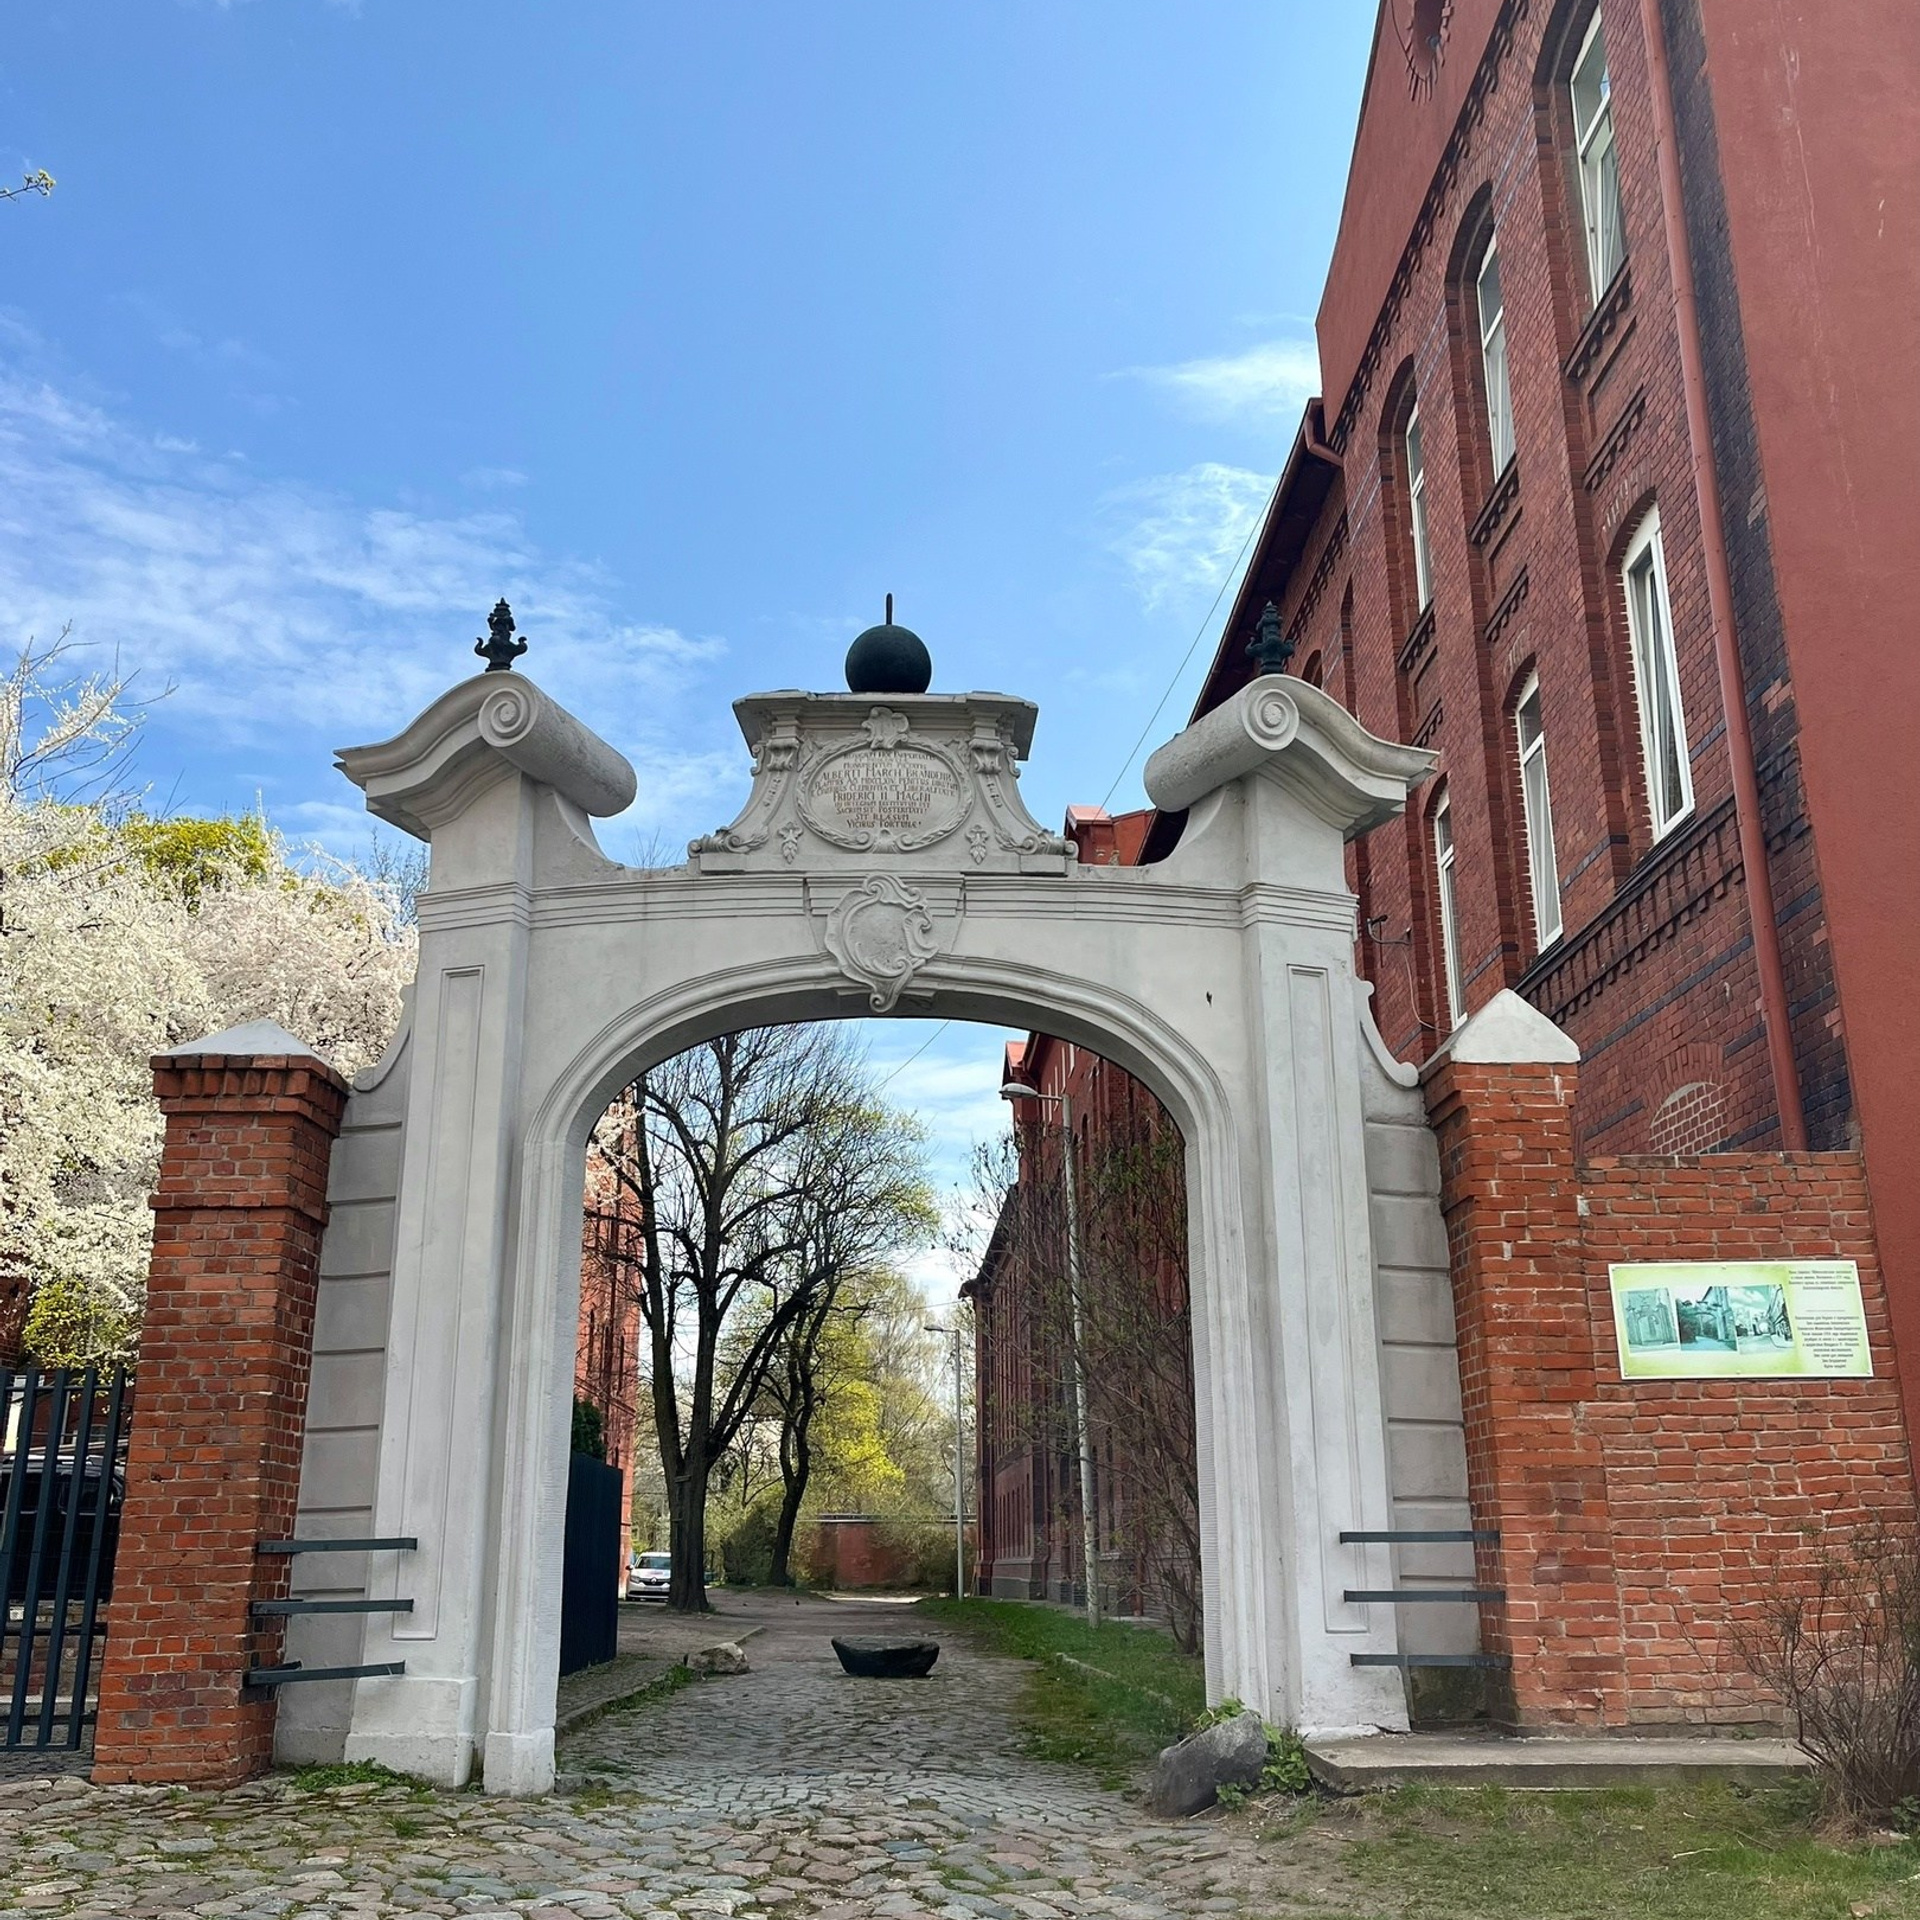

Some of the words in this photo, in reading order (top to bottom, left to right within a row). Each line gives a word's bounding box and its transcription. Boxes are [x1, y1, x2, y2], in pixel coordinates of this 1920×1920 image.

[821, 769, 860, 781] ALBERTI
[833, 790, 875, 802] FRIDERICI
[880, 791, 888, 801] II
